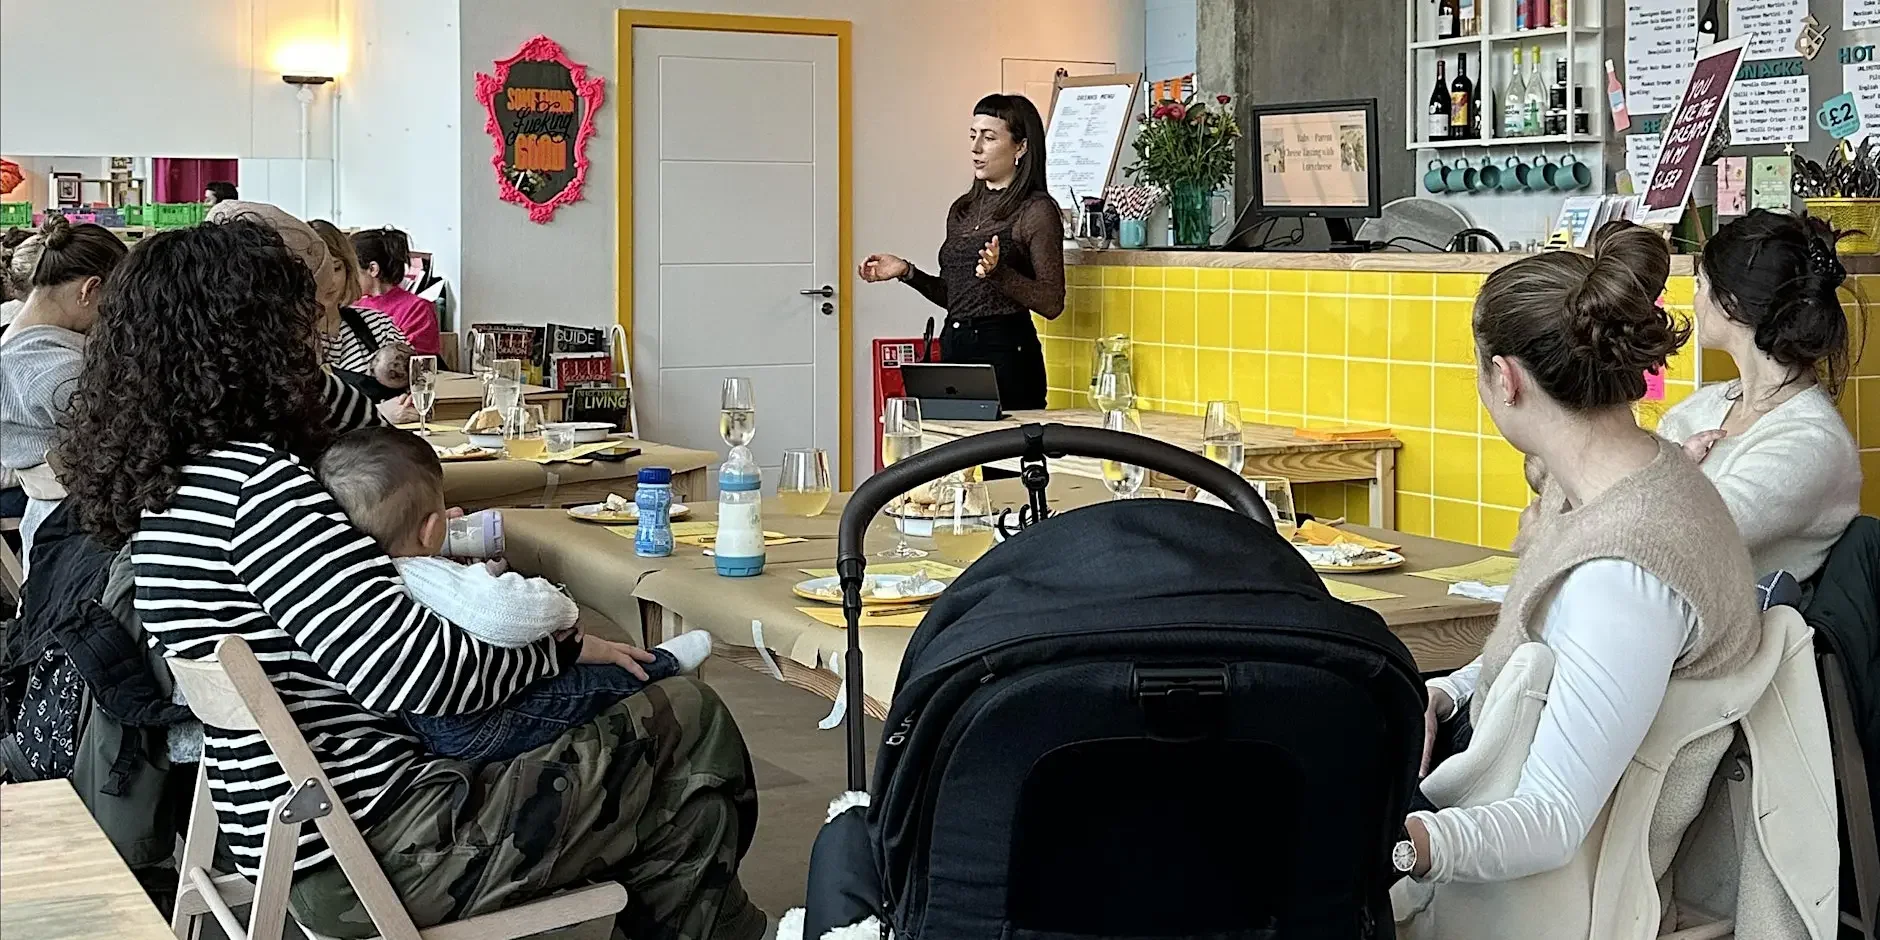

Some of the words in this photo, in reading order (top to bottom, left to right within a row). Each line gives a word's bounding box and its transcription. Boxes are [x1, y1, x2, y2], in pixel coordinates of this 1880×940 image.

[1838, 44, 1875, 64] HOT
[1687, 73, 1715, 102] YOU
[507, 87, 575, 114] SOMETHING
[1676, 103, 1699, 125] ARE
[1695, 96, 1718, 119] THE
[1829, 102, 1854, 127] £2
[1667, 118, 1711, 146] DREAMS
[514, 133, 567, 172] GOOD
[1660, 147, 1675, 165] IN
[1671, 144, 1690, 165] MY
[1652, 169, 1683, 191] SLEEP
[553, 329, 596, 346] GUIDE
[562, 360, 607, 377] ELLE
[584, 395, 628, 410] LIVING
